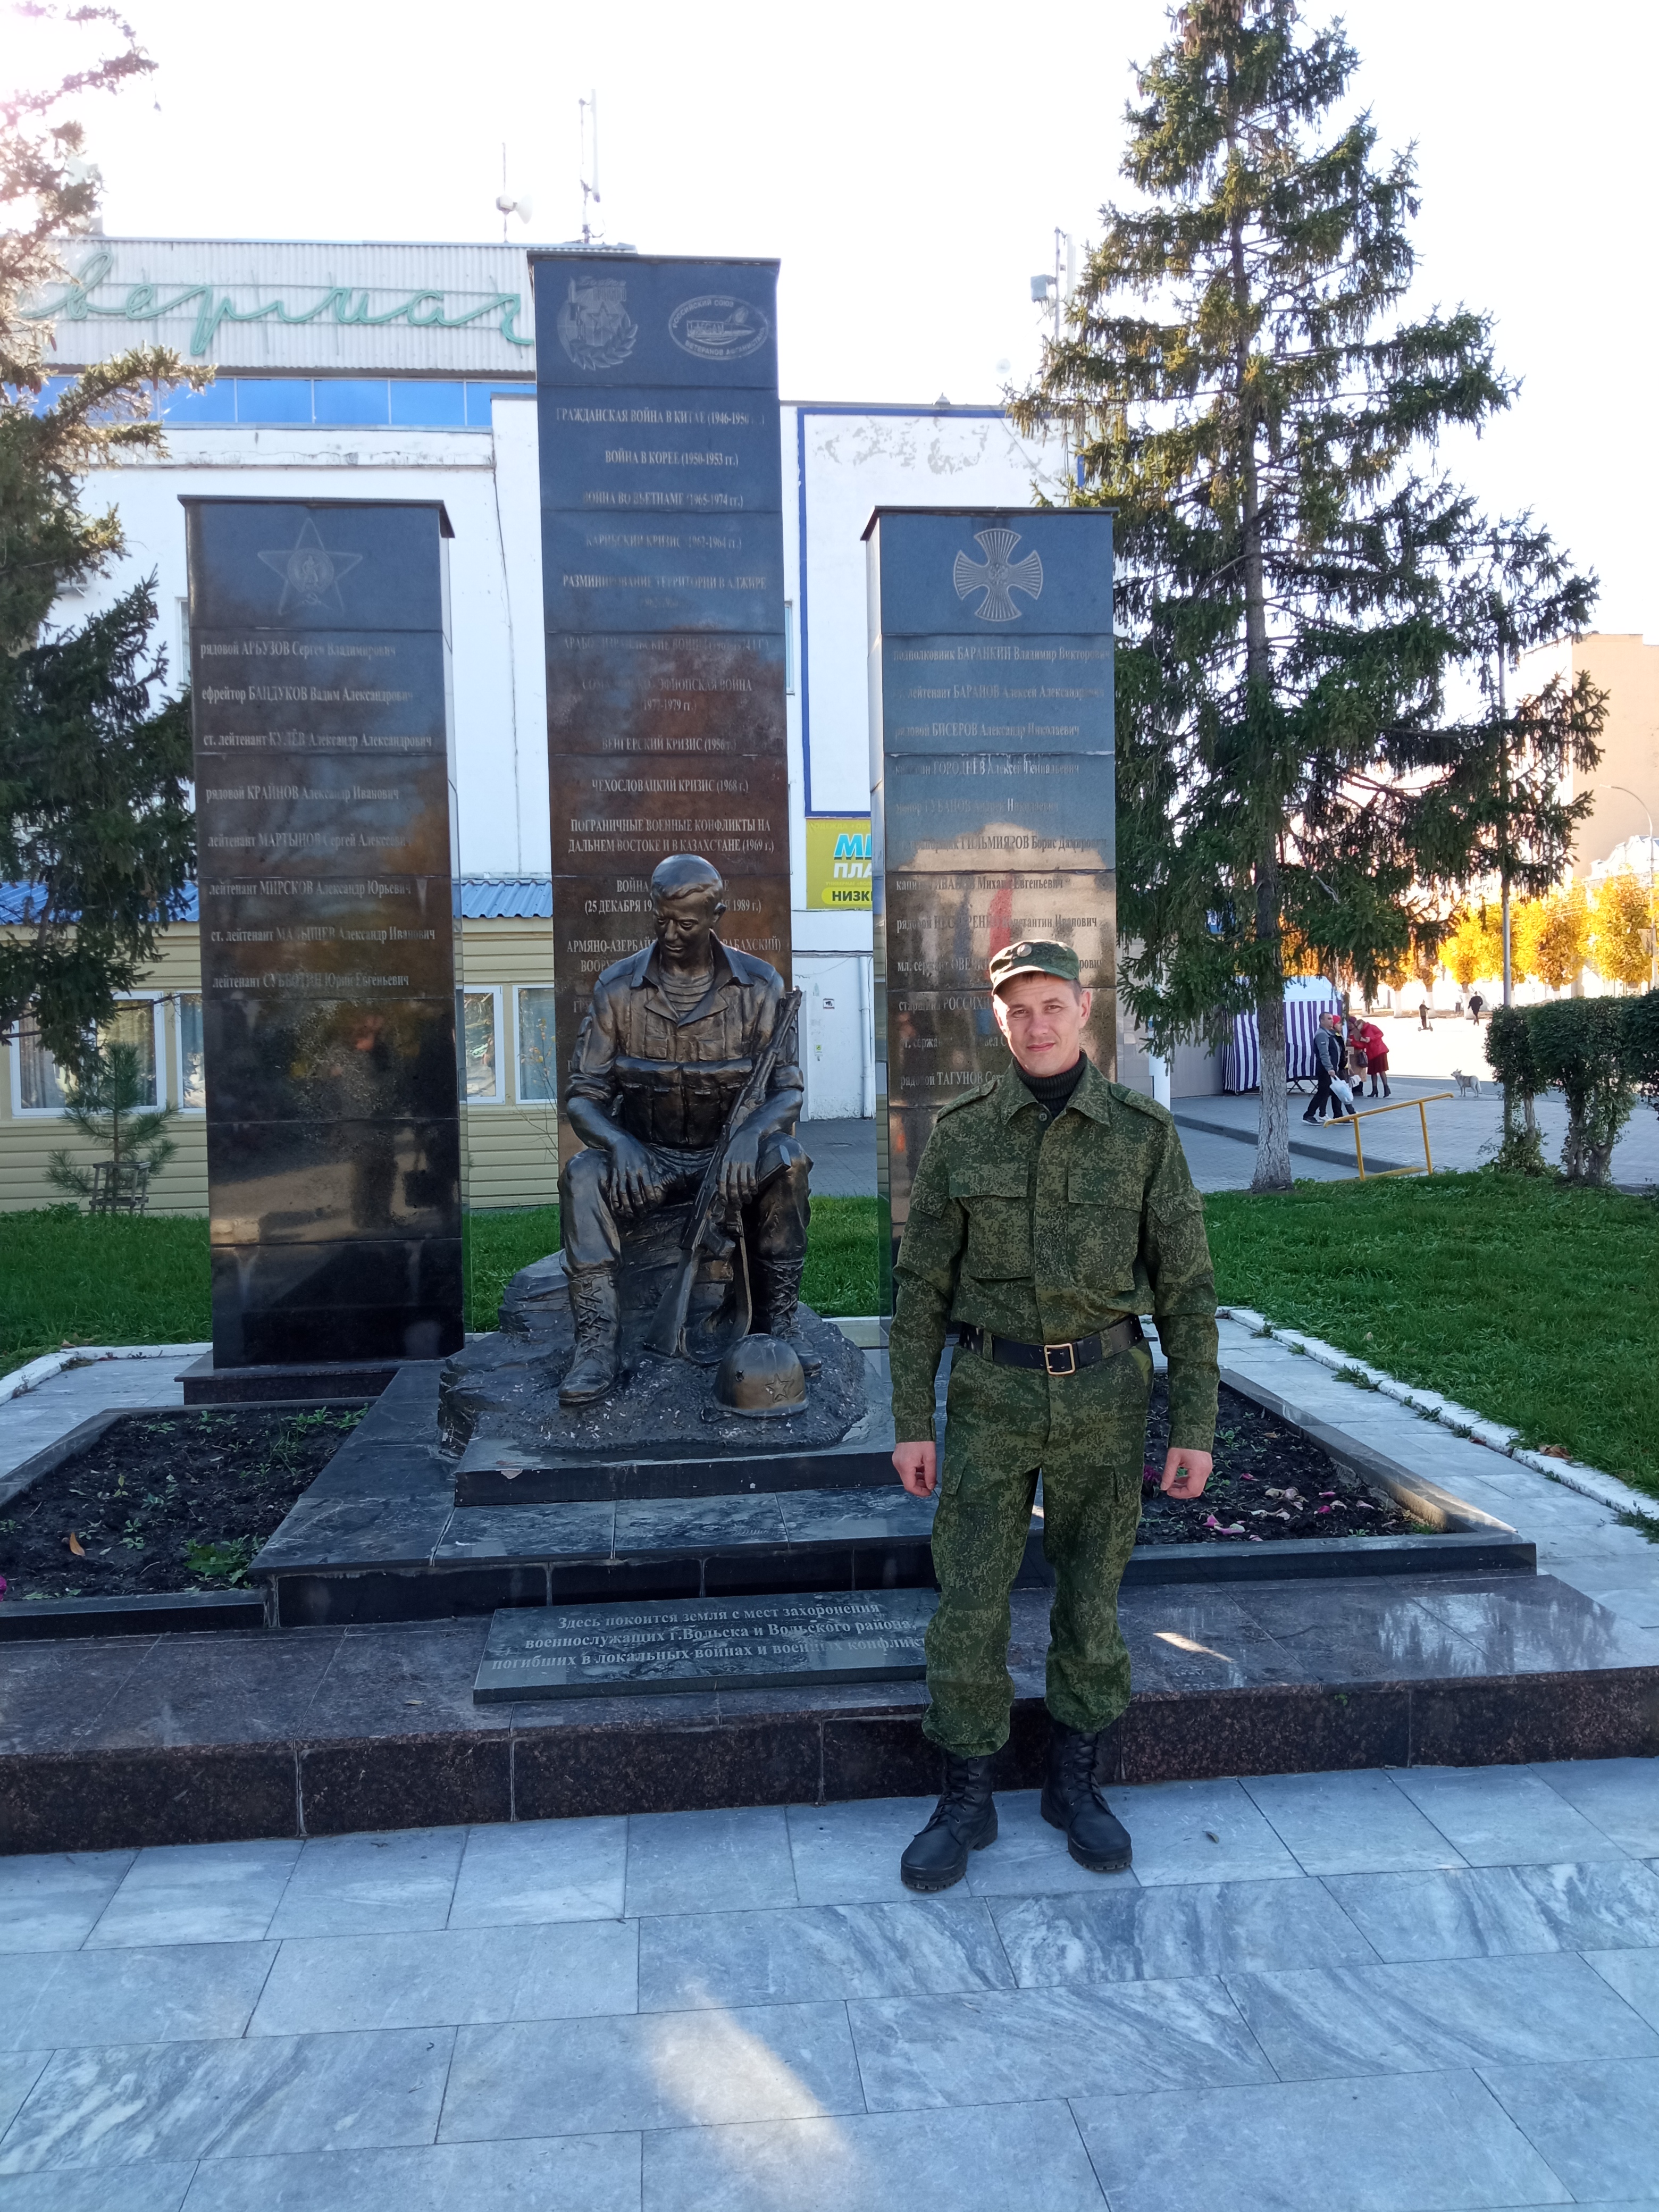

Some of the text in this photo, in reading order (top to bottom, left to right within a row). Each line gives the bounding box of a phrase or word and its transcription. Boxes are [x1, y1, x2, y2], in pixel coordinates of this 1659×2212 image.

[673, 299, 711, 328] РОССИЙСКИЙ
[685, 340, 724, 356] ВЕТЕРАНОВ
[557, 408, 628, 423] ГРАЖДАНСКАЯ
[631, 407, 664, 423] ВОЙНА
[666, 410, 672, 423] В
[605, 448, 639, 464] ВОЙНА
[641, 451, 647, 464] В
[649, 451, 680, 465] КОРЕЕ
[682, 452, 723, 467] (1950-1953
[618, 491, 631, 505] ВО
[200, 640, 239, 659] рядовой
[242, 640, 290, 655] АРБУЗОВ
[958, 646, 1011, 661] БАРАНКИН
[1013, 646, 1057, 664] Владимир
[202, 686, 246, 705] ефрейтор
[310, 686, 340, 702] Вадим
[1028, 722, 1080, 736] Николаевич
[204, 734, 216, 745] ст.
[218, 732, 267, 745] лейтенант
[308, 732, 357, 751] Александр
[362, 733, 431, 751] Александрович
[602, 735, 664, 750] ВЕНГЕРСКИЙ
[666, 738, 702, 750] КРИЗИС
[206, 785, 245, 803] рядовой
[247, 782, 299, 800] КРАЙНОВ
[353, 785, 399, 800] Иванович
[592, 776, 676, 794] ЧЕХОСЛОВАЦКИЙ
[679, 779, 715, 792] КРИЗИС
[717, 779, 737, 793] (1968
[571, 819, 771, 832] ПОГРАНИЧНЫЕ ВОЕННЫЕ КОНФЛИКТЫ НА
[207, 833, 256, 847] лейтенант
[568, 839, 774, 854] ДАЛЬНЕМ ВОСТОКЕ И В КАЗАХСТАНЕ (1969 г.)
[1031, 836, 1057, 853] Борис
[209, 880, 257, 895] лейтенант
[316, 881, 365, 899] Александр
[367, 880, 412, 899] Юрьевич
[616, 877, 649, 893] ВОЙНА
[896, 881, 933, 891] капи
[1013, 877, 1063, 890] Евгеньевич
[832, 891, 873, 901] НИЗК
[585, 900, 597, 916] (25
[598, 900, 641, 915] ДЕКАБРЯ
[644, 900, 653, 912] 19
[733, 899, 750, 911] 1989
[752, 899, 761, 914] г.)
[211, 931, 223, 942] ст.
[225, 928, 274, 942] лейтенант
[338, 927, 387, 944] Александр
[389, 926, 435, 941] Иванович
[567, 936, 657, 953] АРМЯНО-АЗЕРБАЙ
[897, 962, 911, 972] мл.
[213, 974, 261, 988] лейтенант
[901, 1073, 935, 1090] рядоой
[936, 1071, 983, 1085] ТАГУНОВ
[557, 1604, 880, 1630] Здесь покоится земля с мест захоронения
[525, 1632, 665, 1649] военнослужащих
[754, 1626, 764, 1637] и
[767, 1622, 851, 1636] Вольского
[855, 1618, 917, 1635] района,
[491, 1655, 577, 1670] погибших
[581, 1654, 591, 1665] в
[595, 1650, 690, 1664] локальных
[694, 1645, 753, 1658] войнах
[757, 1645, 767, 1655] и
